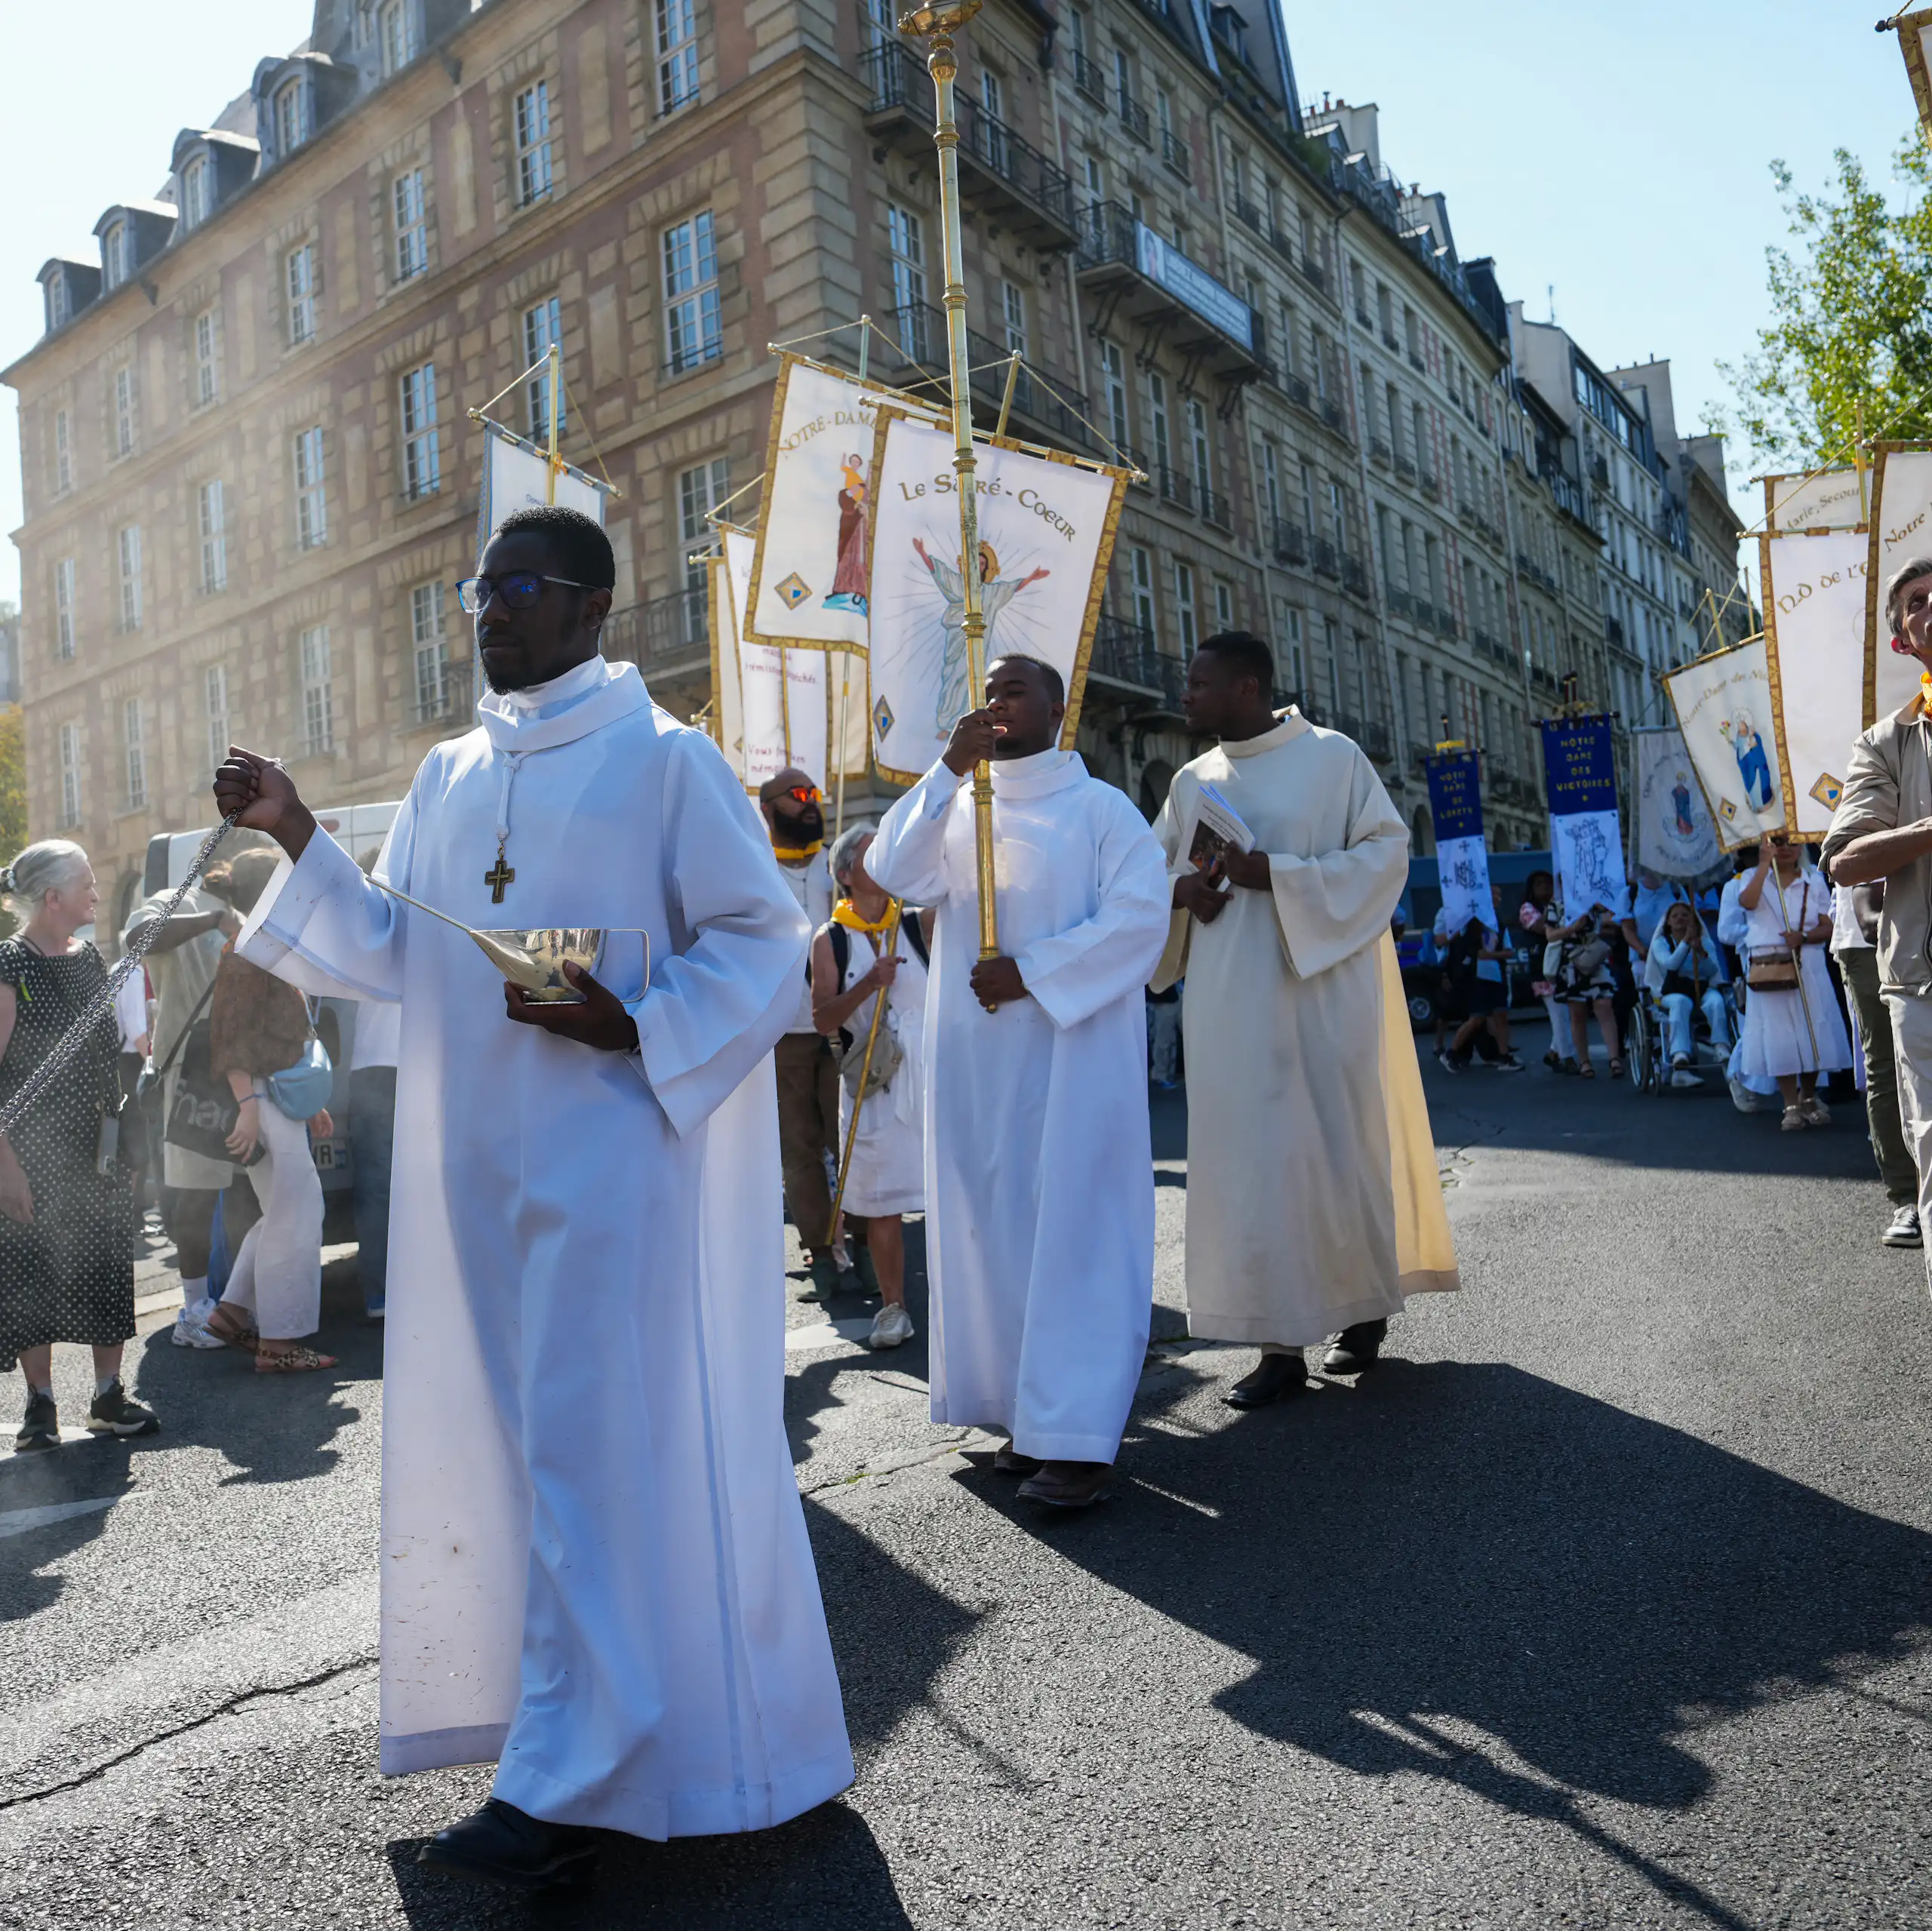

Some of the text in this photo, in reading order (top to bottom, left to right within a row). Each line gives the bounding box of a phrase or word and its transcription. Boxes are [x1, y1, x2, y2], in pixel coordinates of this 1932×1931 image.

[898, 481, 926, 502] Le
[1884, 512, 1924, 553] Notre
[1560, 736, 1595, 748] NOTRE
[1566, 752, 1592, 762] DAME
[1571, 765, 1591, 776] DES
[1555, 778, 1611, 792] VICTOIRES
